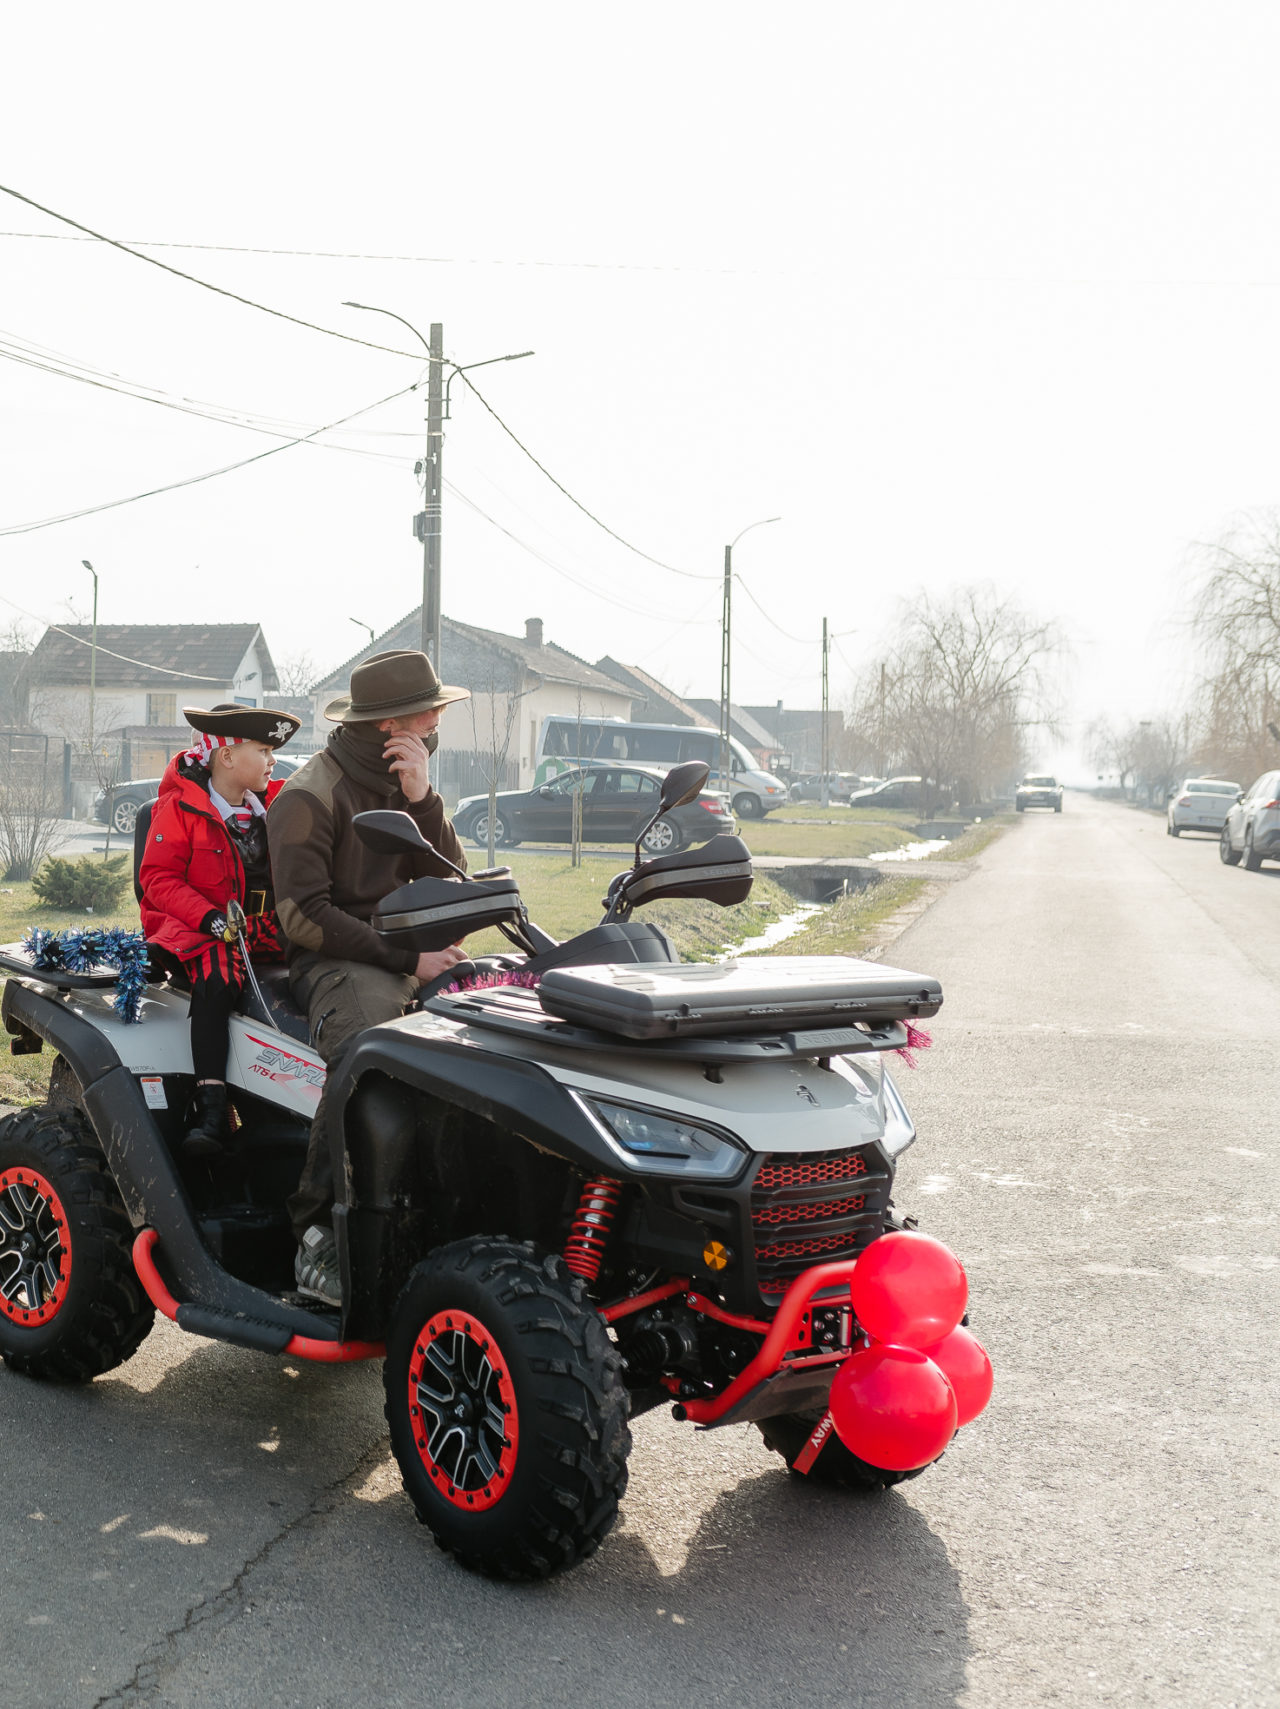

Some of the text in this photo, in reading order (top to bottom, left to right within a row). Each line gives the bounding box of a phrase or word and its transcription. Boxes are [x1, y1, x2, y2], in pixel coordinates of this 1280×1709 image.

[703, 866, 741, 876] SEGWAY
[423, 903, 466, 920] SEGWAY
[800, 1031, 858, 1044] SEGWAY
